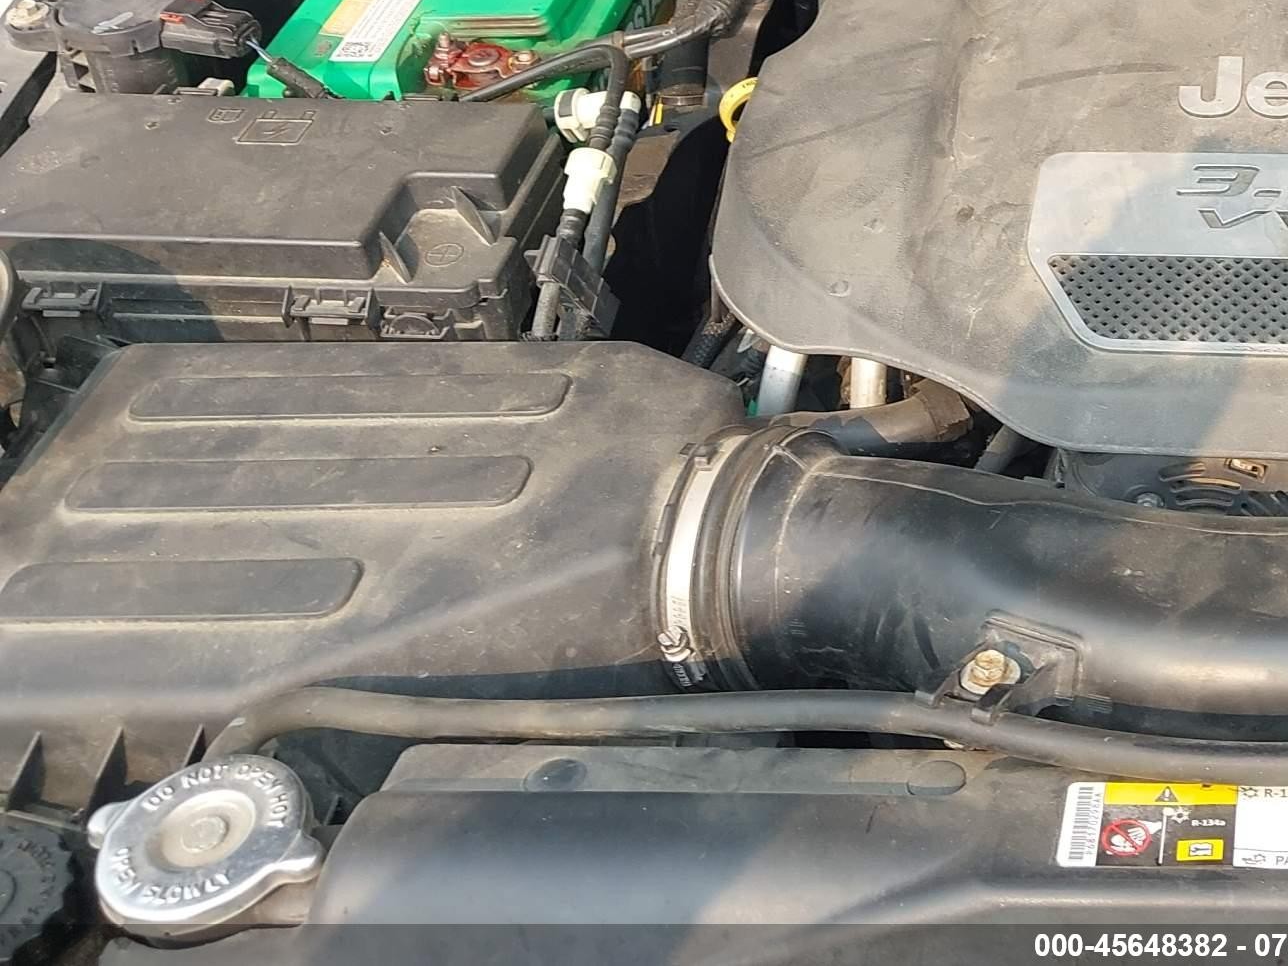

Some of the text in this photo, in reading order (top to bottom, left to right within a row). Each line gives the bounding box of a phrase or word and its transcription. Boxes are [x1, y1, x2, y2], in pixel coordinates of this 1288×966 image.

[141, 764, 292, 828] DO NOT OPEN HOT
[1191, 819, 1227, 827] R-134a
[143, 871, 234, 904] SLOWLY
